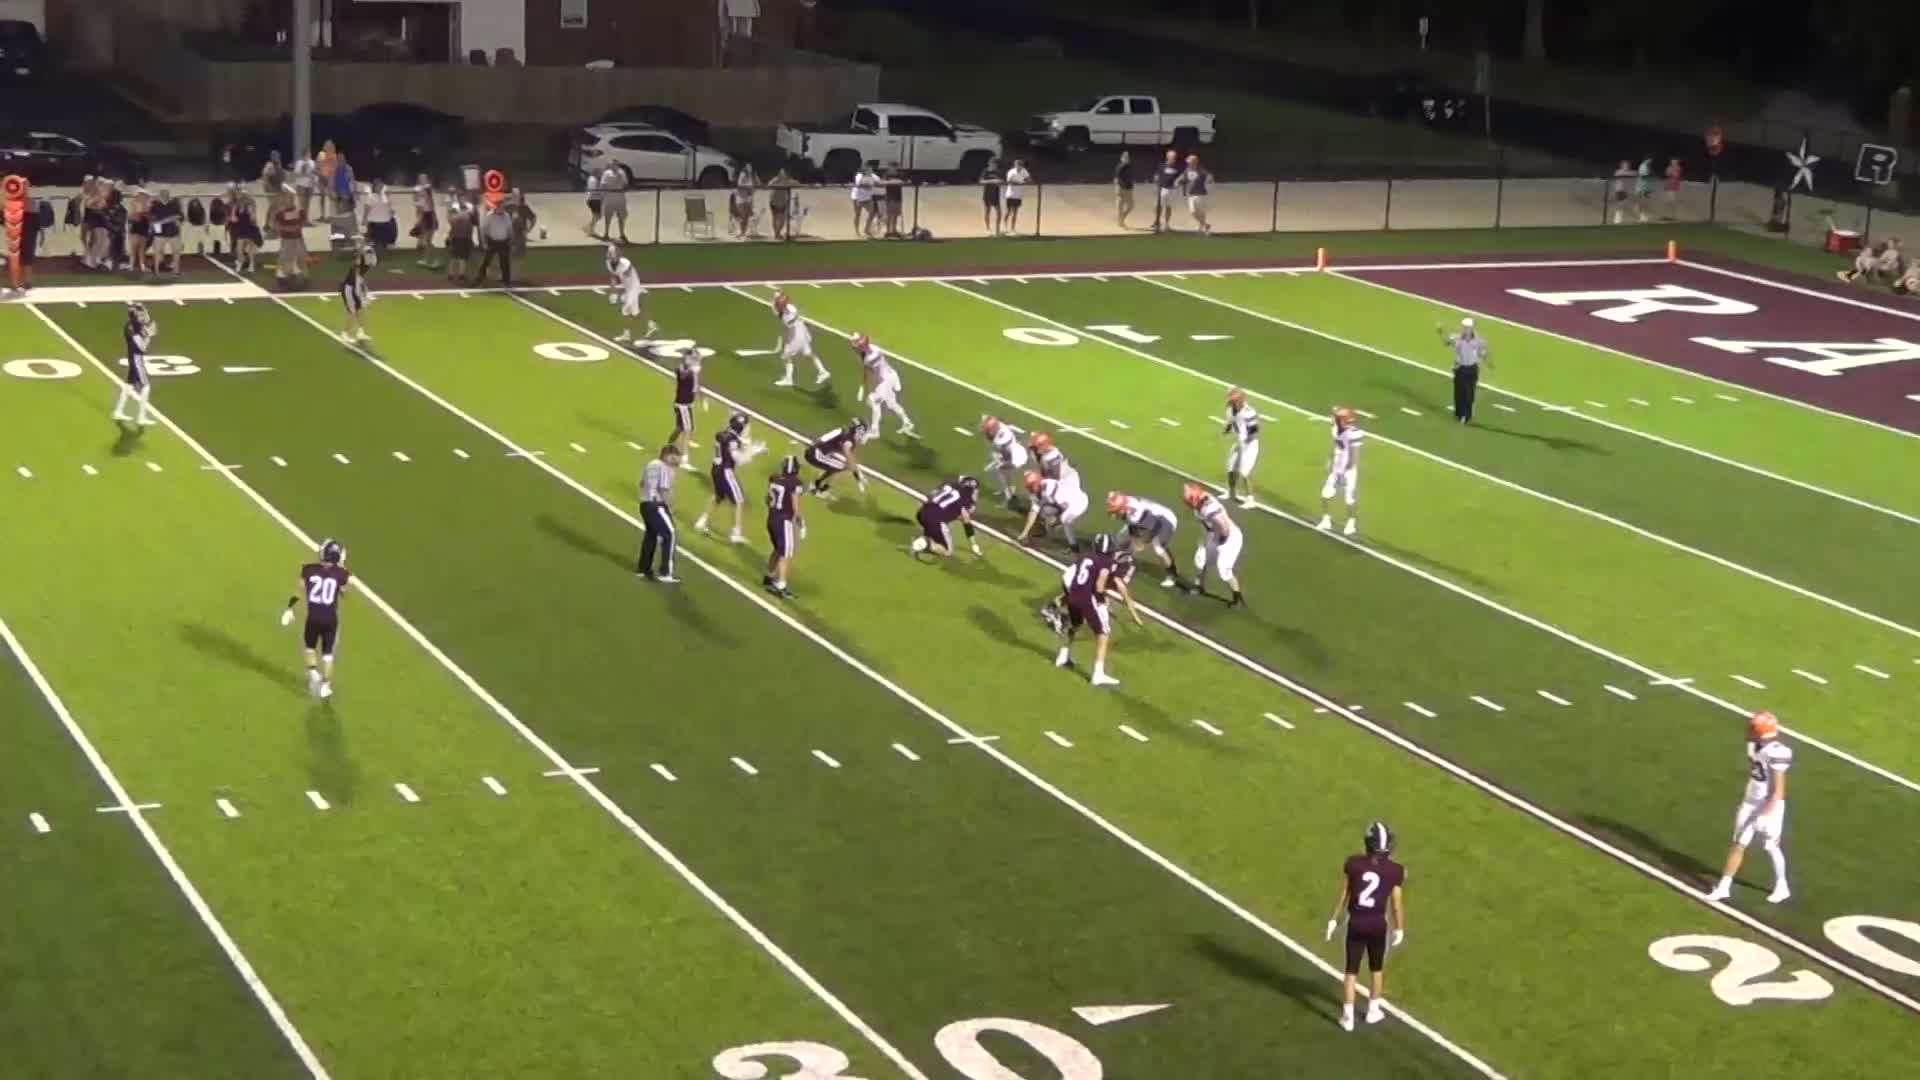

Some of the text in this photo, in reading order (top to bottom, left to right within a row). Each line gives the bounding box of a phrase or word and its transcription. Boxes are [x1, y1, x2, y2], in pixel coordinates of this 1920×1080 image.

[1505, 284, 1920, 380] RA
[308, 574, 338, 605] 20
[1358, 871, 1381, 909] 2
